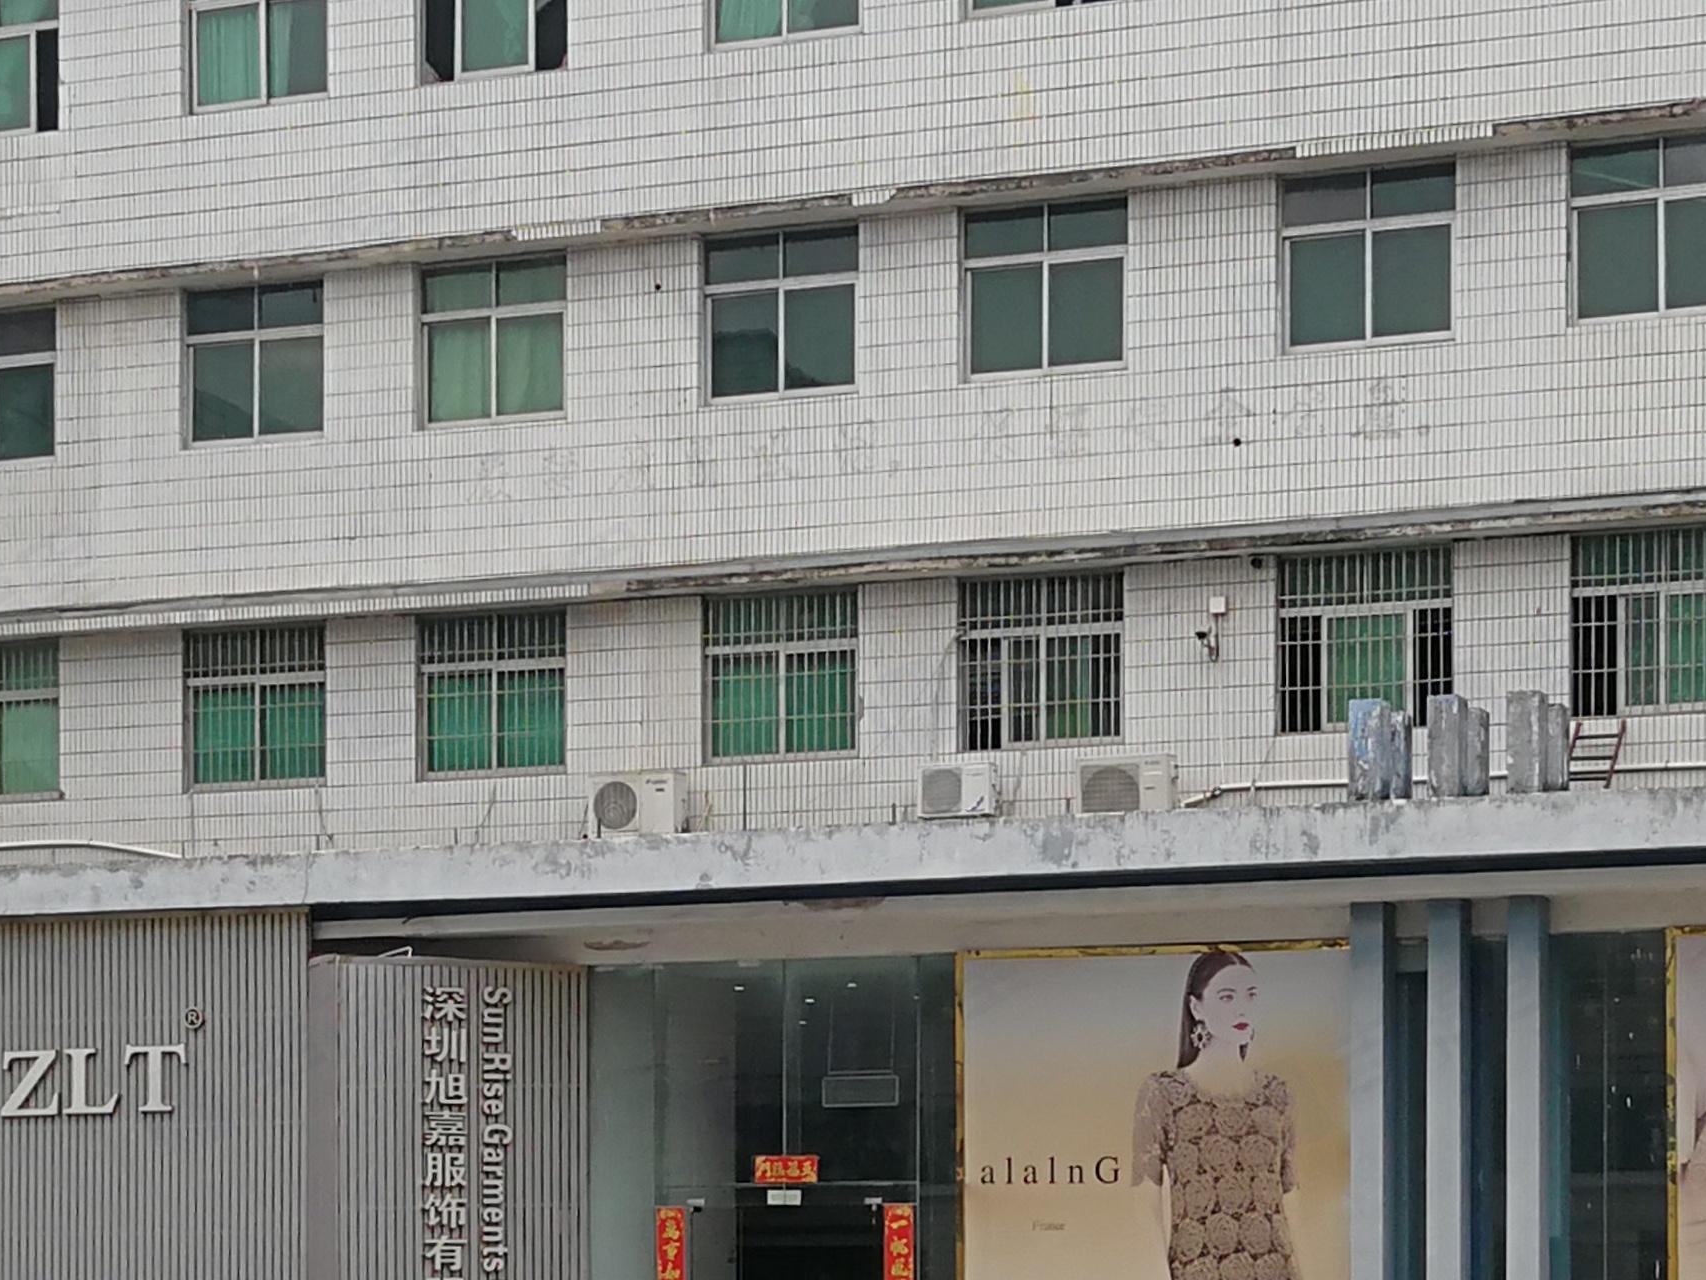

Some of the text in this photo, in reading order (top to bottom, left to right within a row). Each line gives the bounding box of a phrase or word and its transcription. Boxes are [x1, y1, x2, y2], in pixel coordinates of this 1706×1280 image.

[483, 986, 513, 1043] Sun
[0, 1043, 187, 1118] ZLT
[483, 1053, 513, 1115] Rise
[483, 1123, 513, 1273] Garments
